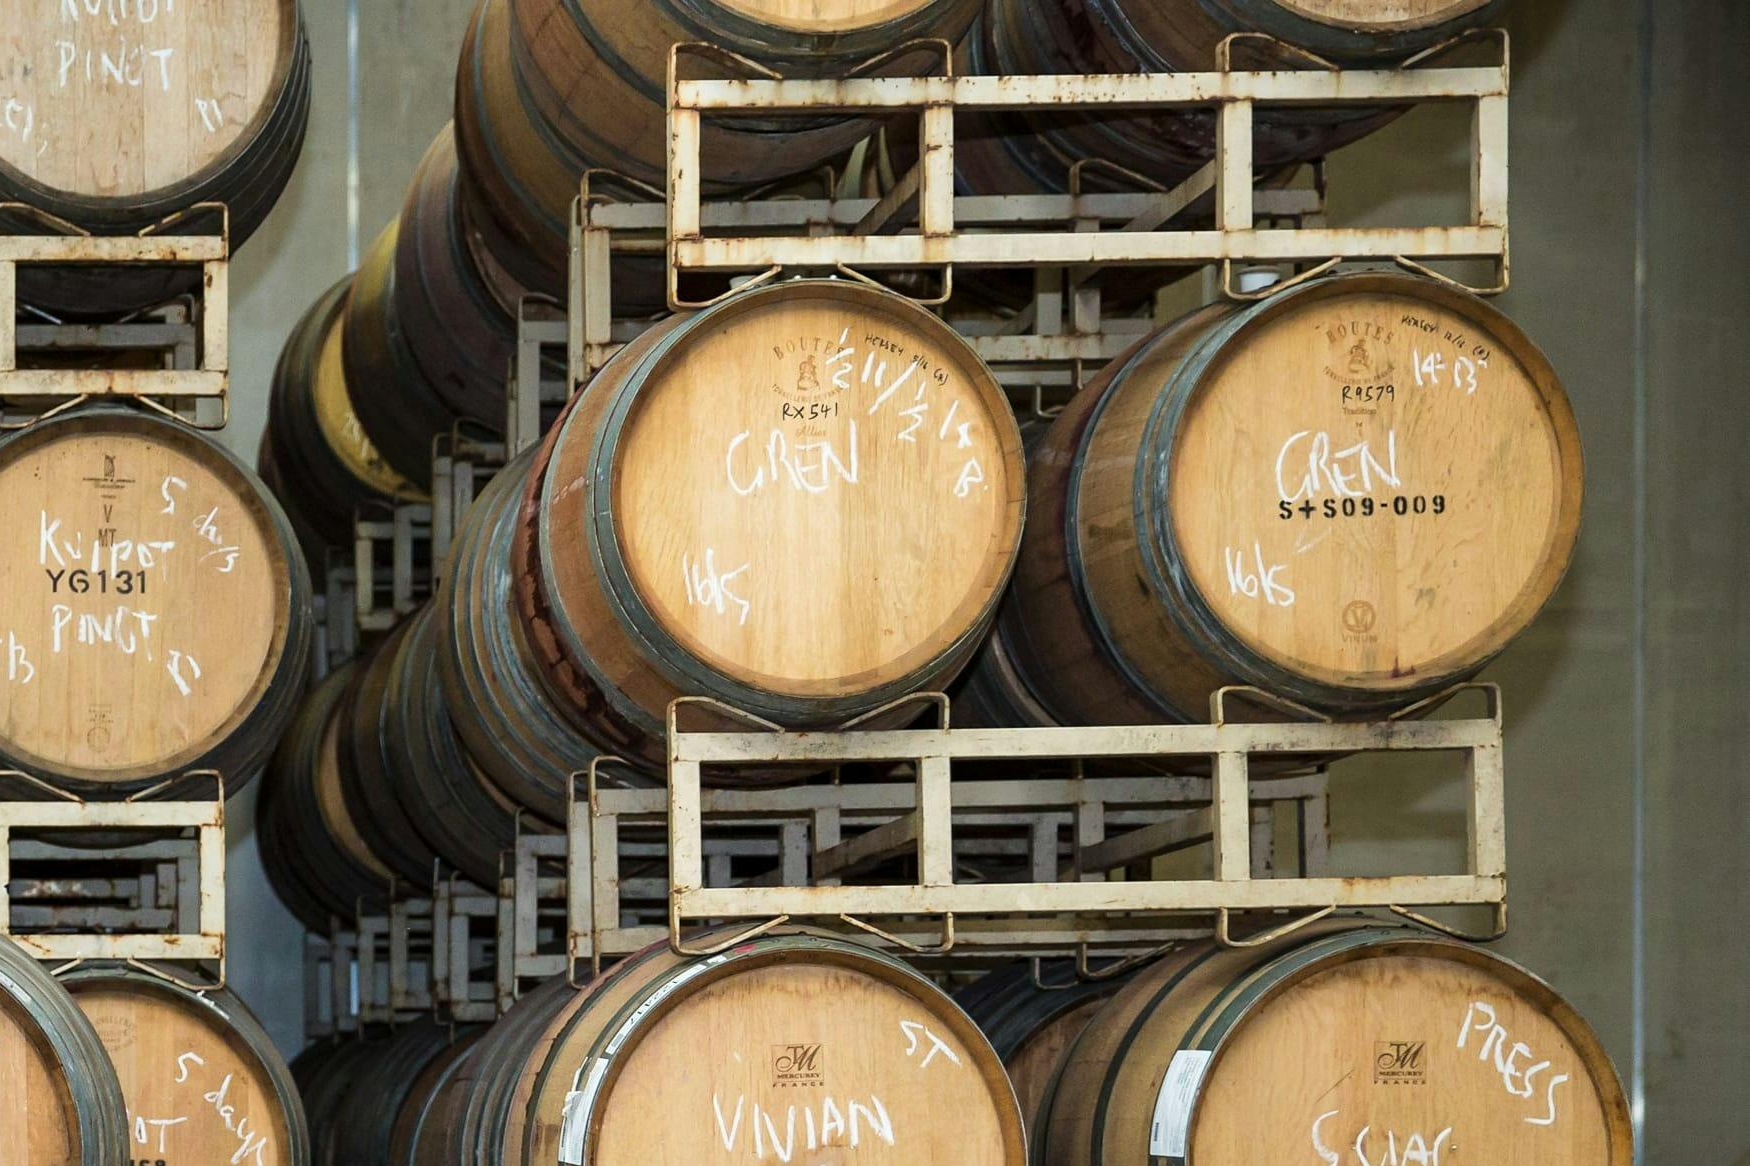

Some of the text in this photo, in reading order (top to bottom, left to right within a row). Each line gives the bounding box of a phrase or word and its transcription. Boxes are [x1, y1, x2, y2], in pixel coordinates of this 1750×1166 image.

[55, 34, 174, 92] PINOT
[725, 418, 859, 497] GREN
[1275, 429, 1401, 503] GREN
[1278, 494, 1447, 521] S+S09-009
[45, 568, 148, 596] YG131
[52, 603, 158, 663] PINOT
[1456, 1001, 1570, 1126] PRESS
[712, 1094, 896, 1163] VIVIAN
